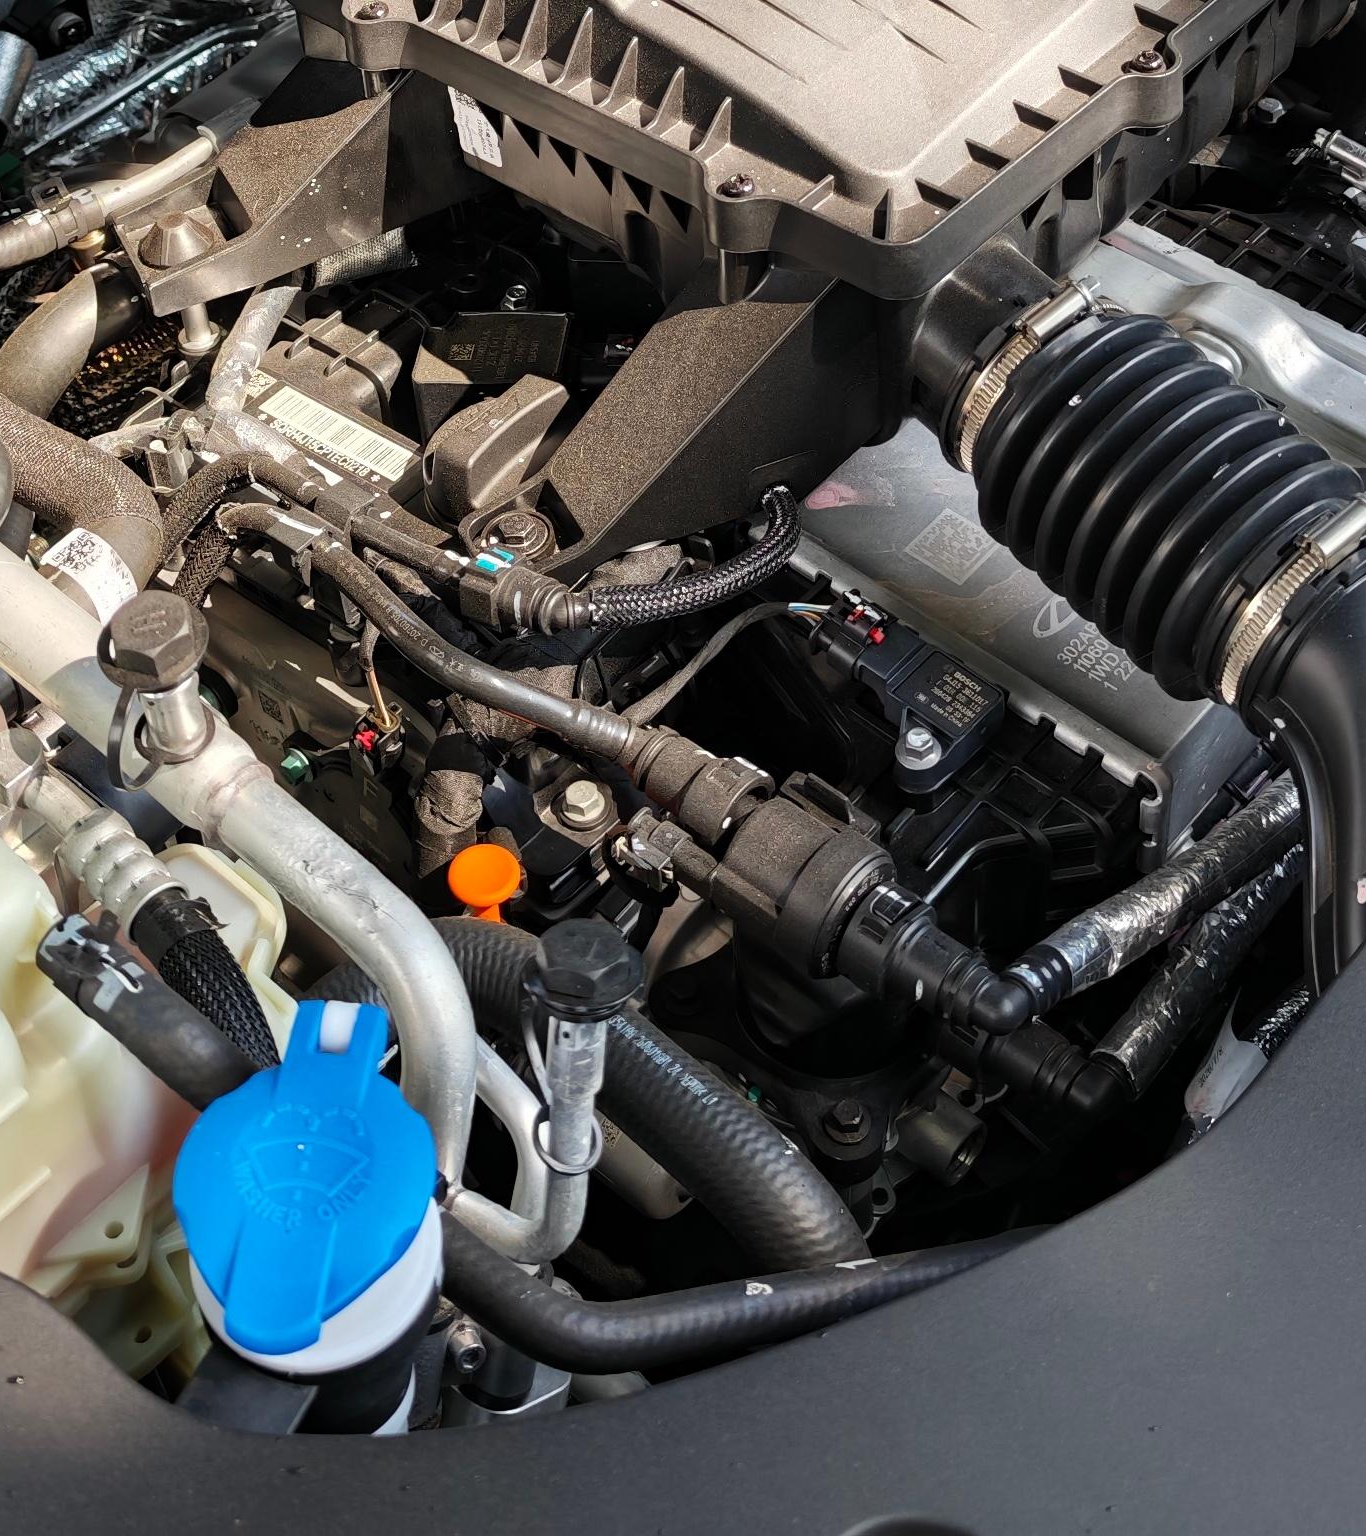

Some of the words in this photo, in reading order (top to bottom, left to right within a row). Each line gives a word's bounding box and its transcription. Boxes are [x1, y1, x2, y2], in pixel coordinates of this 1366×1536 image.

[954, 671, 982, 692] BOSCH
[1088, 652, 1119, 682] 1WD
[234, 1161, 303, 1228] WASHER
[316, 1171, 372, 1221] ONLY
